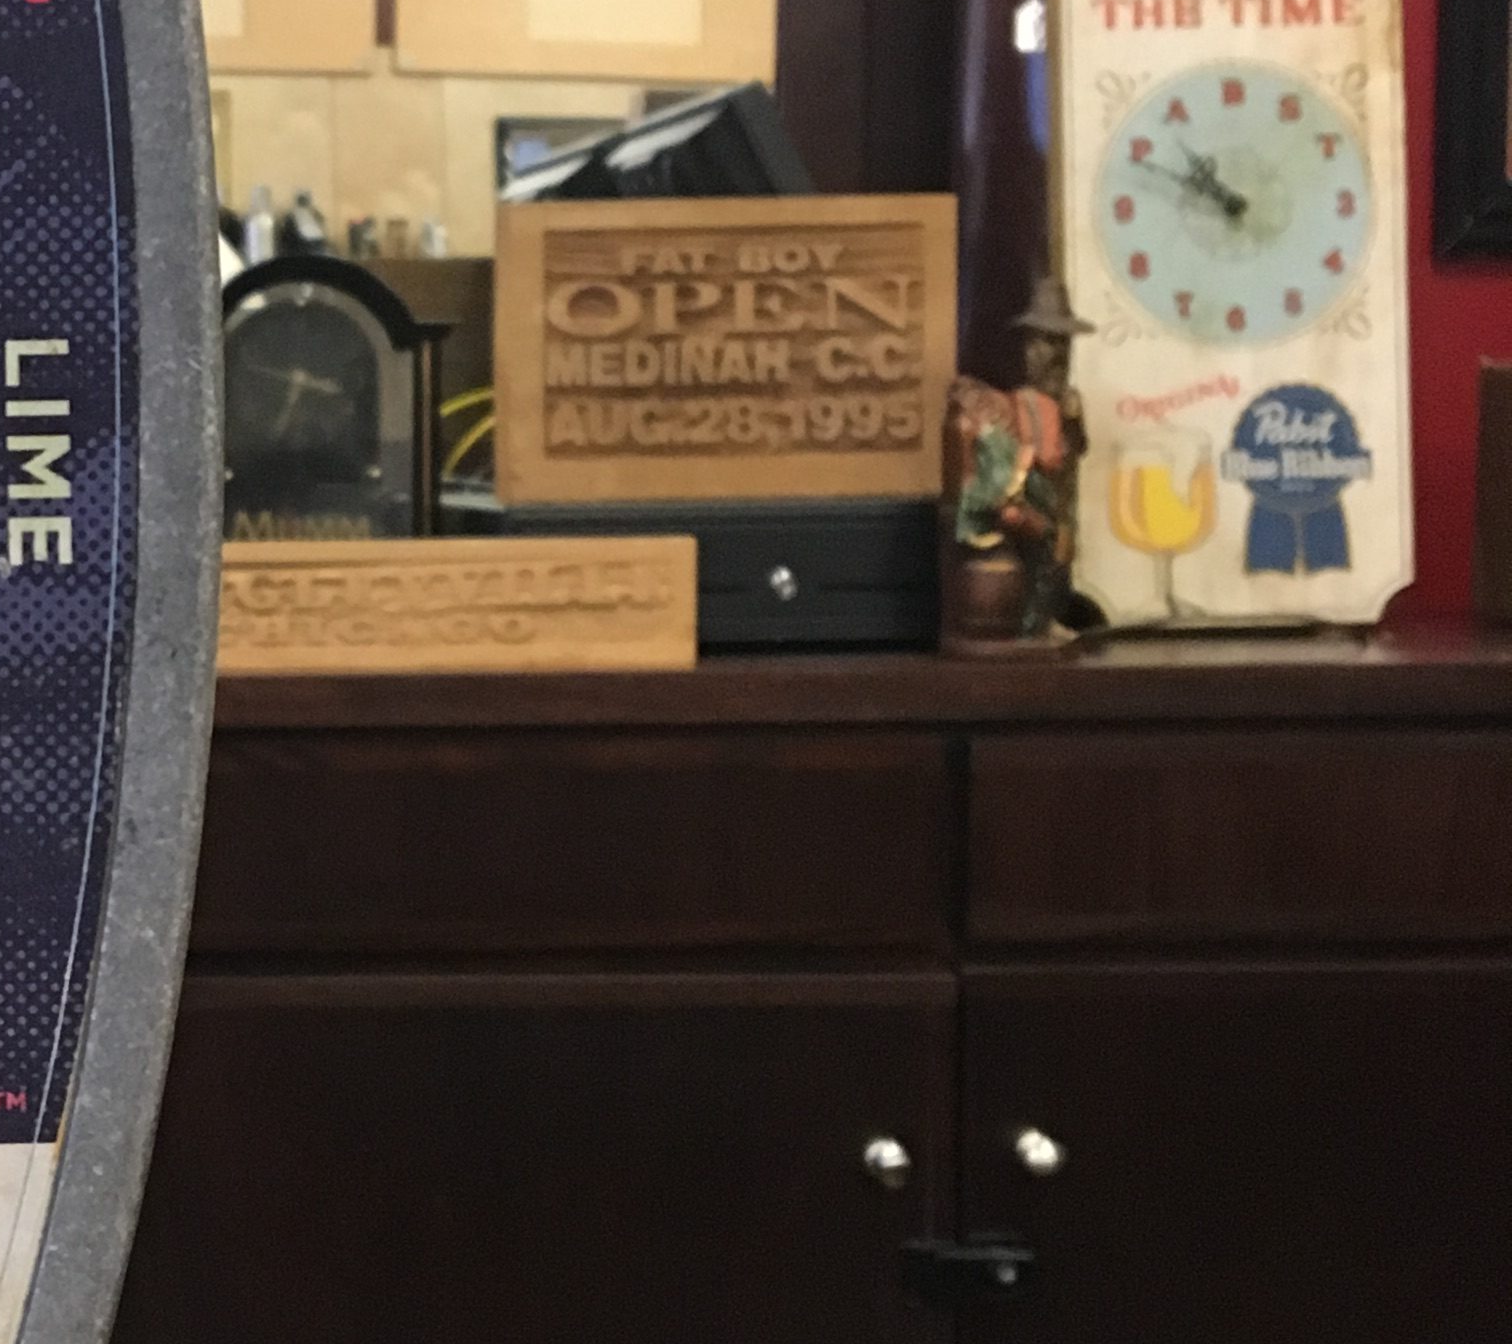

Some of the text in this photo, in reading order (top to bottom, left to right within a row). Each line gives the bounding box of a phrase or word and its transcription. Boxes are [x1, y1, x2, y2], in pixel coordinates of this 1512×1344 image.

[618, 242, 845, 276] FAT BOY
[546, 273, 912, 338] OPEN
[544, 338, 790, 387] MEDINAH
[4, 339, 76, 567] LIME
